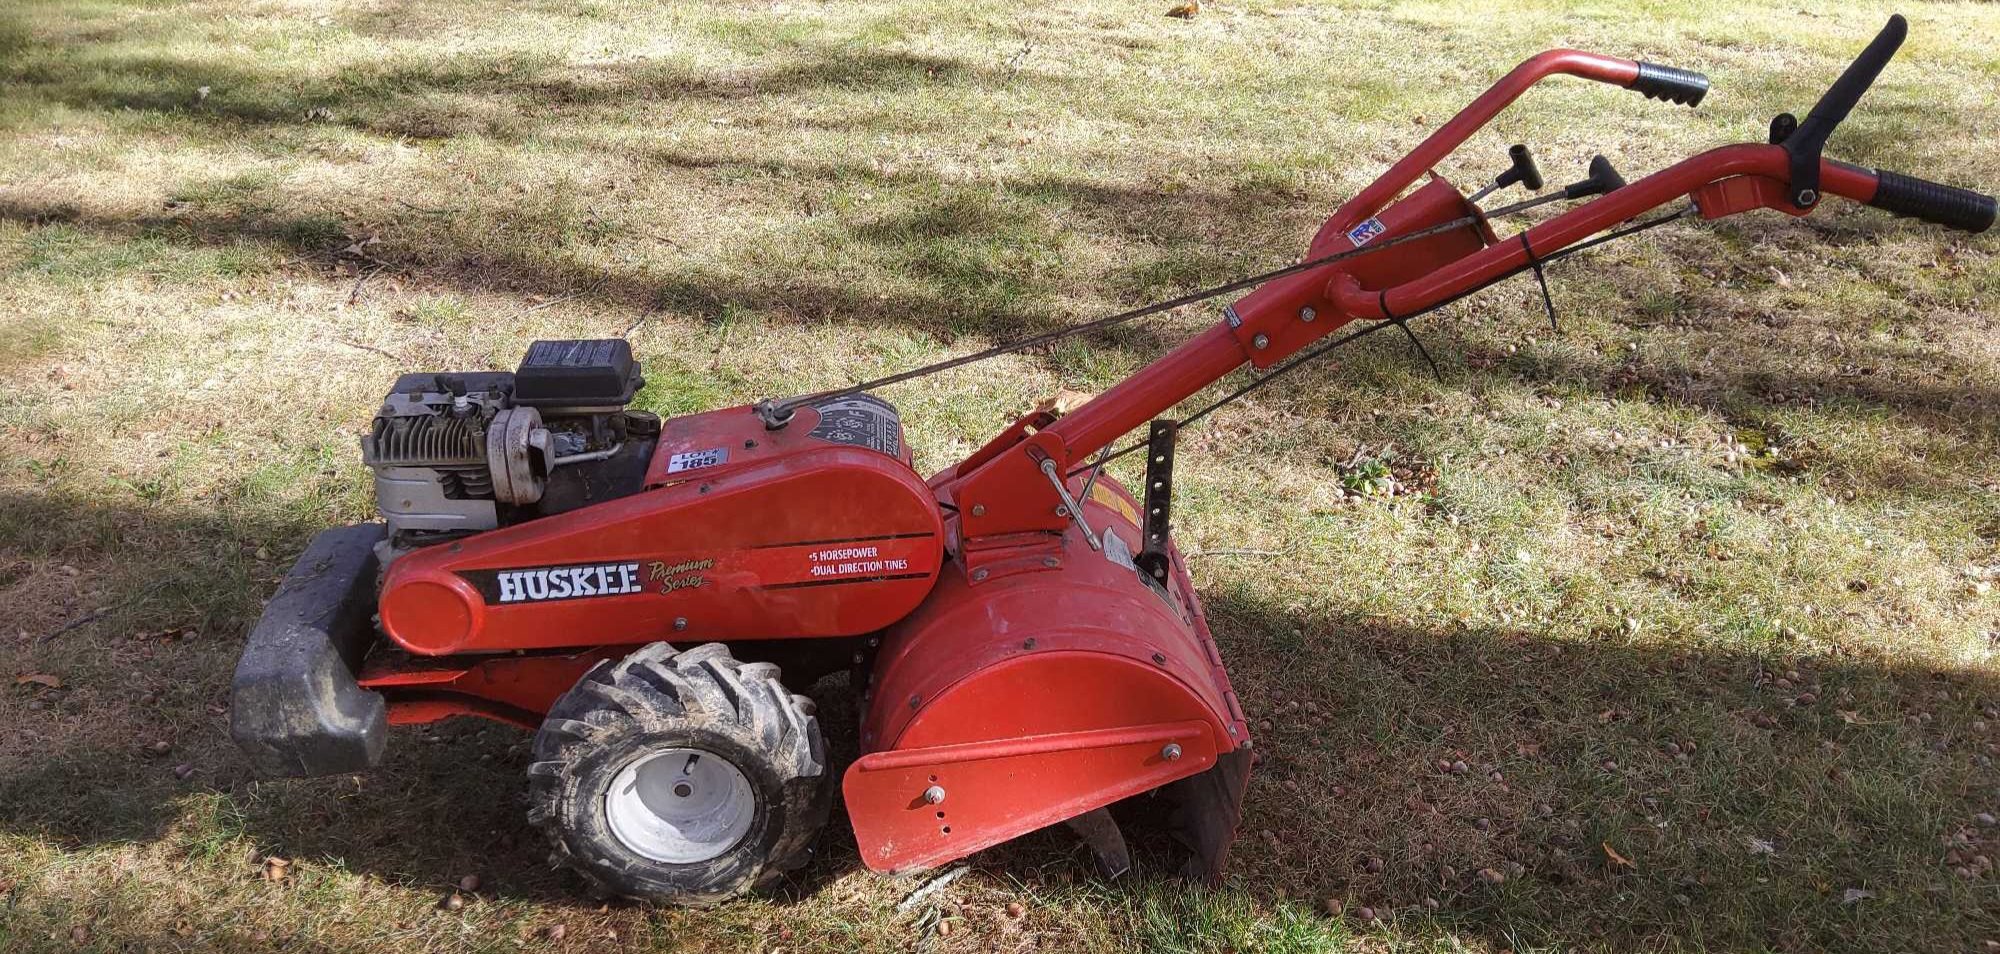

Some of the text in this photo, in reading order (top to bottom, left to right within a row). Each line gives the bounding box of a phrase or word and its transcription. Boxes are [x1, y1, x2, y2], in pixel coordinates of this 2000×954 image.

[680, 456, 717, 469] 185
[819, 547, 878, 562] HORSEPOWER
[648, 557, 715, 581] Premium
[838, 561, 883, 574] DIRECTION
[884, 559, 908, 570] TINES
[497, 563, 642, 602] HUSKEE
[660, 575, 712, 595] Series
